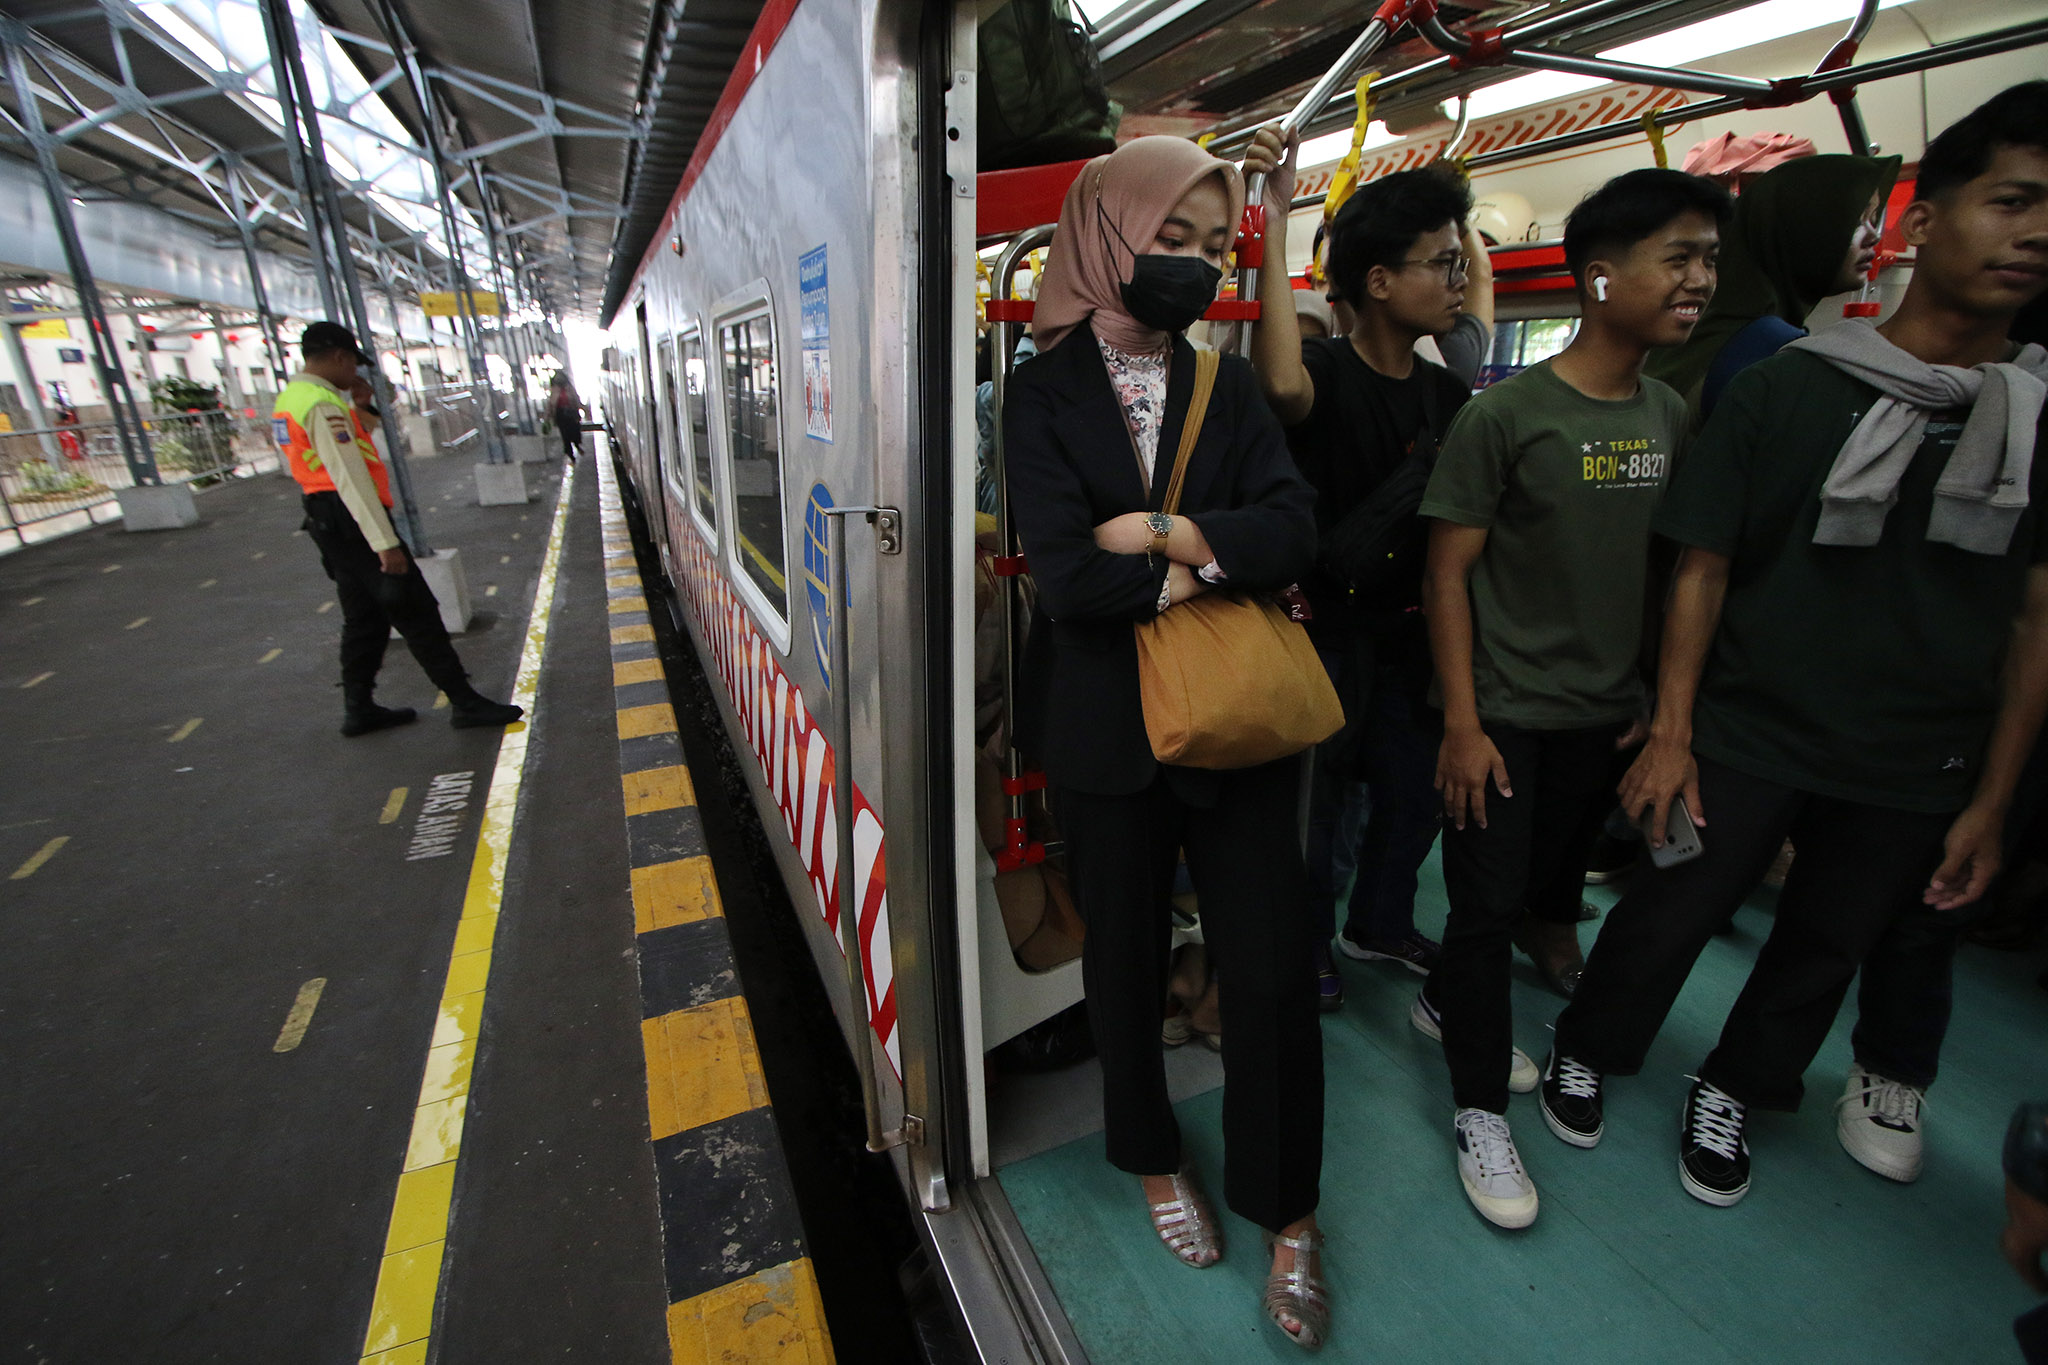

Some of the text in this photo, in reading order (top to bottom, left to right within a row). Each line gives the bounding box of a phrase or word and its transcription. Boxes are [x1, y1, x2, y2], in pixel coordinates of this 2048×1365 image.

[1609, 439, 1648, 452] TEXAS
[1583, 453, 1665, 481] BCN 8827
[405, 771, 475, 861] BATAS AMAN
